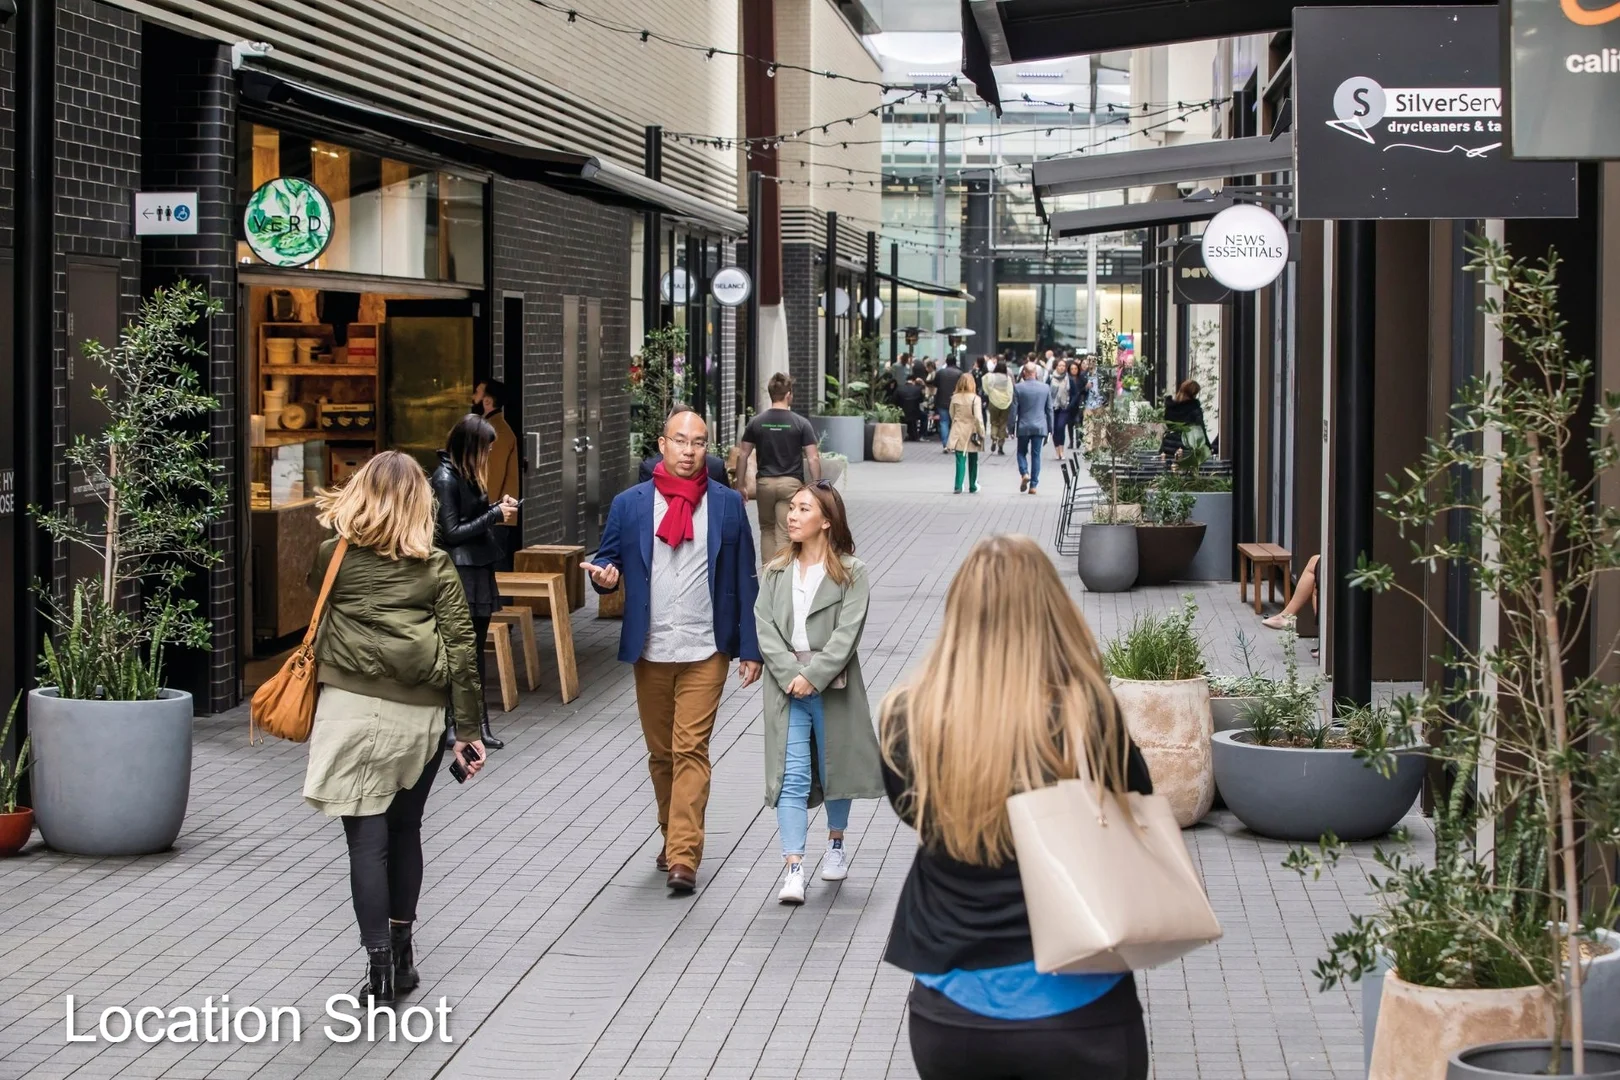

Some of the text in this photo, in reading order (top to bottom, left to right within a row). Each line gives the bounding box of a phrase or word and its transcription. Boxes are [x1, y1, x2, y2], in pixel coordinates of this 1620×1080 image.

[1566, 48, 1620, 73] cali
[1387, 120, 1471, 135] drycleaners
[1473, 120, 1484, 132] &
[253, 215, 321, 232] VERD
[1225, 234, 1266, 246] NEWS
[1208, 246, 1283, 258] ESSENTIALS
